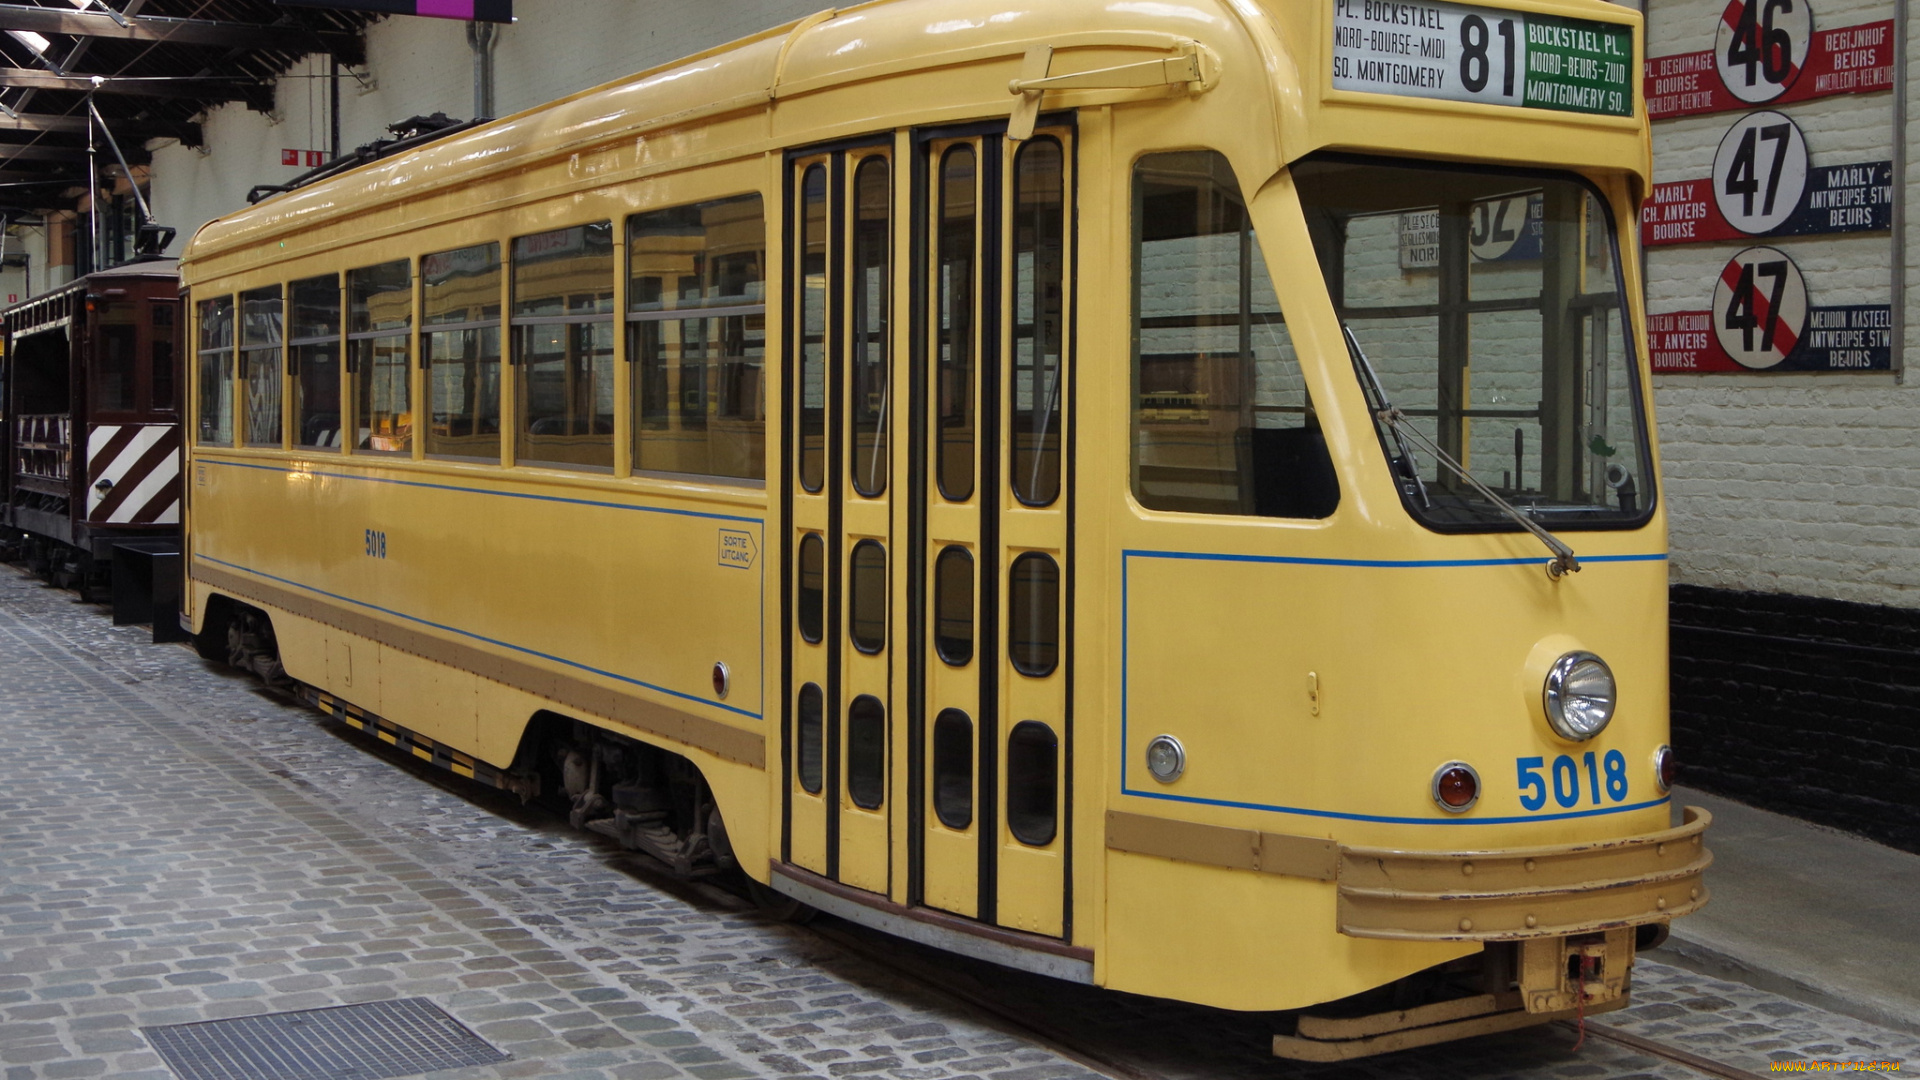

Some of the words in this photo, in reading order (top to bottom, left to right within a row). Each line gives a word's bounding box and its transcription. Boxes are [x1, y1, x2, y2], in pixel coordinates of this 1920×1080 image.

[1337, 0, 1359, 19] PL.
[1364, 0, 1445, 30] BOCKSTAEL
[1529, 23, 1601, 53] BOCKSTAEL
[1604, 34, 1625, 56] PL.
[1728, 0, 1793, 86] 46
[1825, 27, 1887, 52] BEGIJNHOF
[1459, 14, 1516, 97] 81
[1660, 53, 1713, 77] BEGUINAGE
[1834, 49, 1876, 70] BEURS
[1333, 56, 1353, 79] SQ.
[1357, 59, 1445, 89] MONTGOMERY
[1656, 74, 1699, 95] BOURSE
[1527, 79, 1606, 110] MONTGOMERY
[1608, 91, 1625, 113] SQ.
[1725, 122, 1791, 217] 47
[1828, 167, 1875, 188] MARLY
[1655, 185, 1694, 204] MARLY
[1810, 188, 1866, 209] ANTWERPSE
[1643, 206, 1660, 223] CH.
[1664, 202, 1706, 221] ANVERS
[1830, 207, 1872, 227] BEURS
[1653, 221, 1695, 240] BOURSE
[1725, 260, 1788, 352] 47
[1647, 315, 1674, 332] HATEAU
[1677, 314, 1710, 331] MEUDON
[1810, 311, 1846, 328] MEUDON
[1851, 310, 1891, 328] KASTEEL
[1664, 333, 1708, 350] ANVERS
[1810, 330, 1865, 348] ANTWERPSE
[1654, 352, 1697, 368] BOURSE
[1830, 350, 1871, 367] BEURS
[365, 528, 386, 559] 5018
[724, 535, 747, 549] SORTIE
[721, 549, 749, 563] UITGANG
[1516, 749, 1628, 811] 5018
